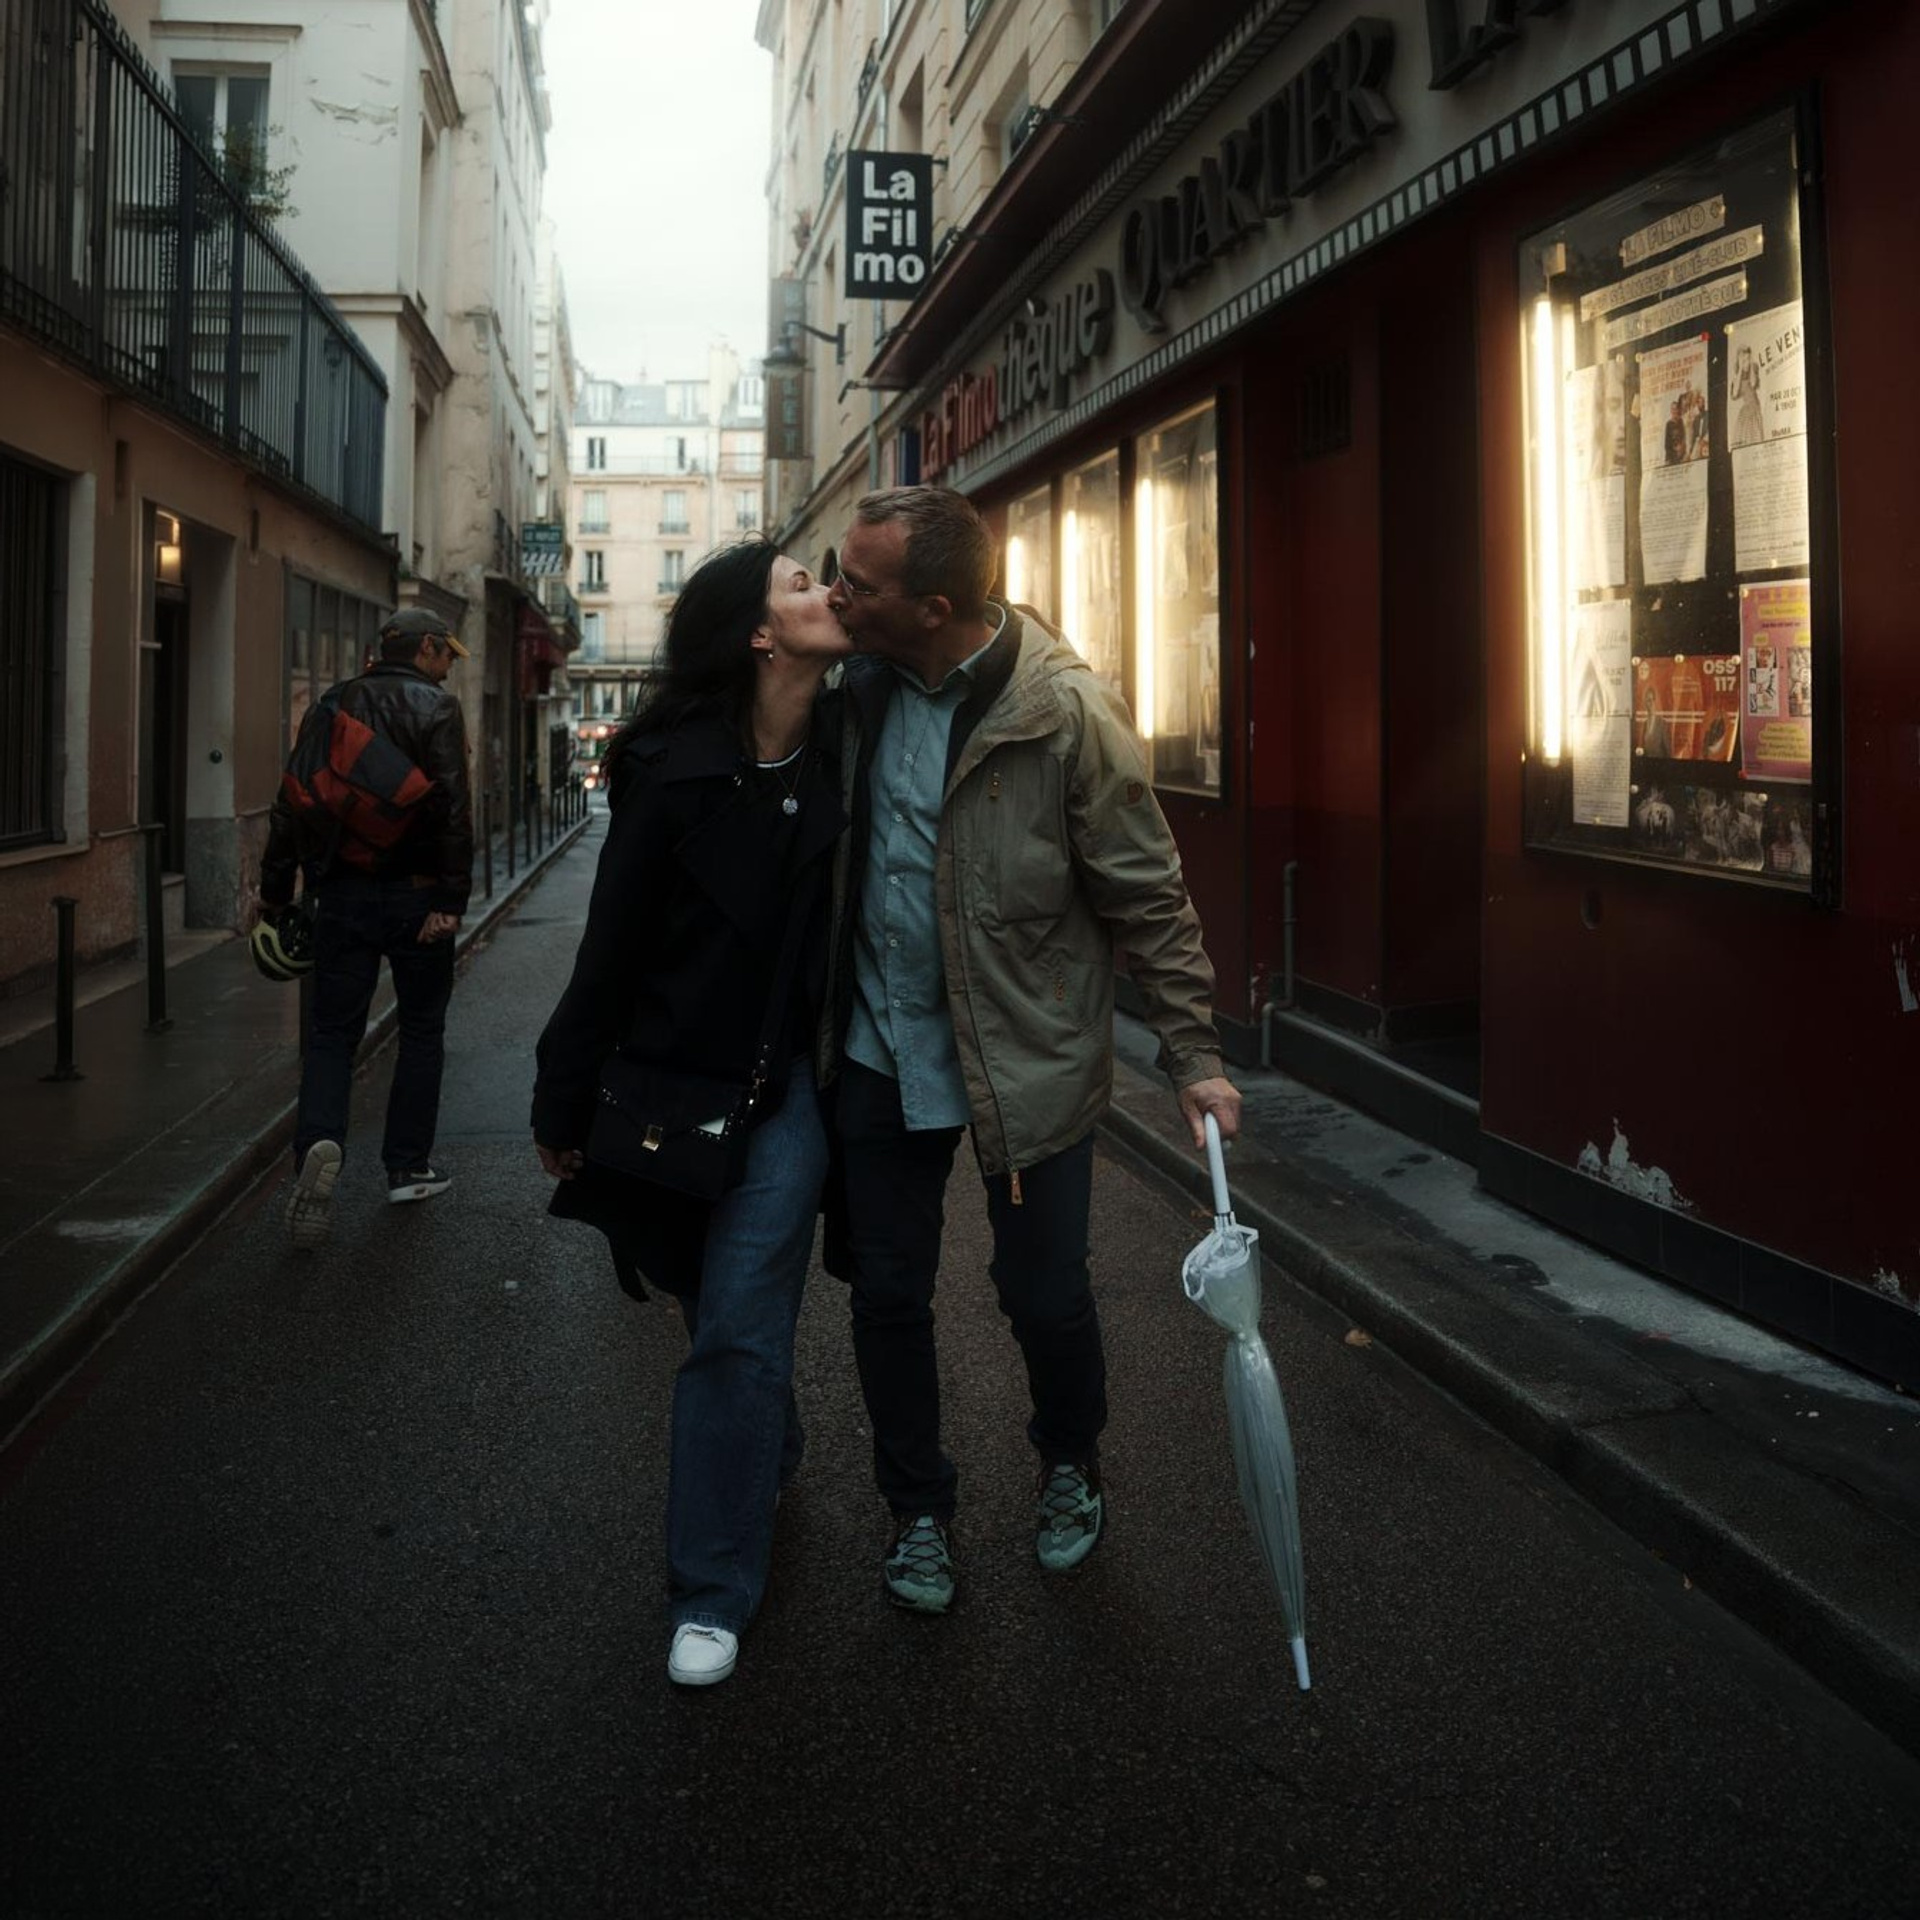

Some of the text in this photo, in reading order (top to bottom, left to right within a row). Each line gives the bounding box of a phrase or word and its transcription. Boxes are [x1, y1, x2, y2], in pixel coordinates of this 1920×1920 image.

[863, 160, 916, 201] La
[1118, 17, 1397, 334] QUARTIER
[862, 206, 918, 248] Fil
[1647, 205, 1706, 250] FILMO
[853, 251, 926, 285] mo
[1758, 346, 1773, 368] LE
[1702, 659, 1737, 675] OSS
[1714, 676, 1737, 692] 117
